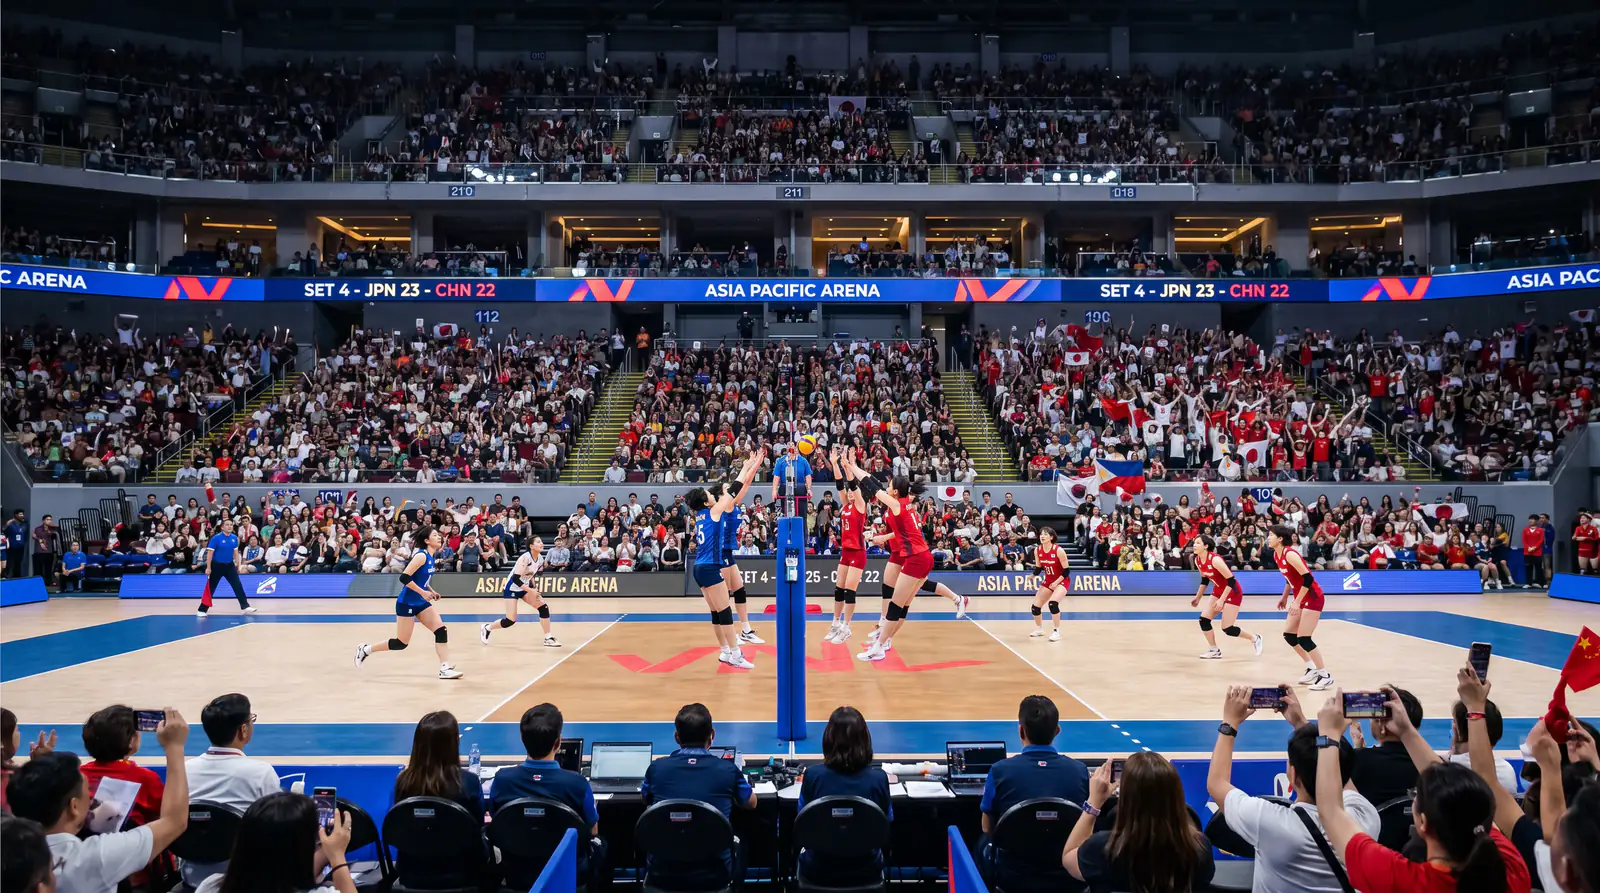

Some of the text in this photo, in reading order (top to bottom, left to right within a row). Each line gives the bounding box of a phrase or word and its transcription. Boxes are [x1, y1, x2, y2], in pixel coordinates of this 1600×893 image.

[451, 187, 473, 196] 210
[784, 188, 802, 197] 211
[16, 271, 87, 289] ARENA
[1507, 269, 1600, 289] ASIA PAC
[305, 283, 334, 297] SET
[339, 283, 350, 297] 4
[365, 283, 395, 297] JPN
[401, 283, 419, 297] 23
[436, 283, 471, 297] CHN
[476, 283, 495, 297] 22
[705, 284, 881, 297] ASIA PACIFIC ARENA
[1101, 284, 1130, 297] SET
[1135, 284, 1146, 297] 4
[1160, 284, 1190, 297] JPN
[1196, 284, 1214, 297] 23
[1230, 284, 1265, 297] CHN
[1270, 284, 1289, 297] 22
[476, 311, 499, 322] 112
[1257, 489, 1273, 501] 10
[761, 571, 769, 583] 4
[806, 571, 820, 583] 25
[865, 571, 880, 583] 22
[978, 576, 1011, 591] ASIA
[1074, 575, 1121, 591] ARENA
[570, 577, 618, 593] ARENA
